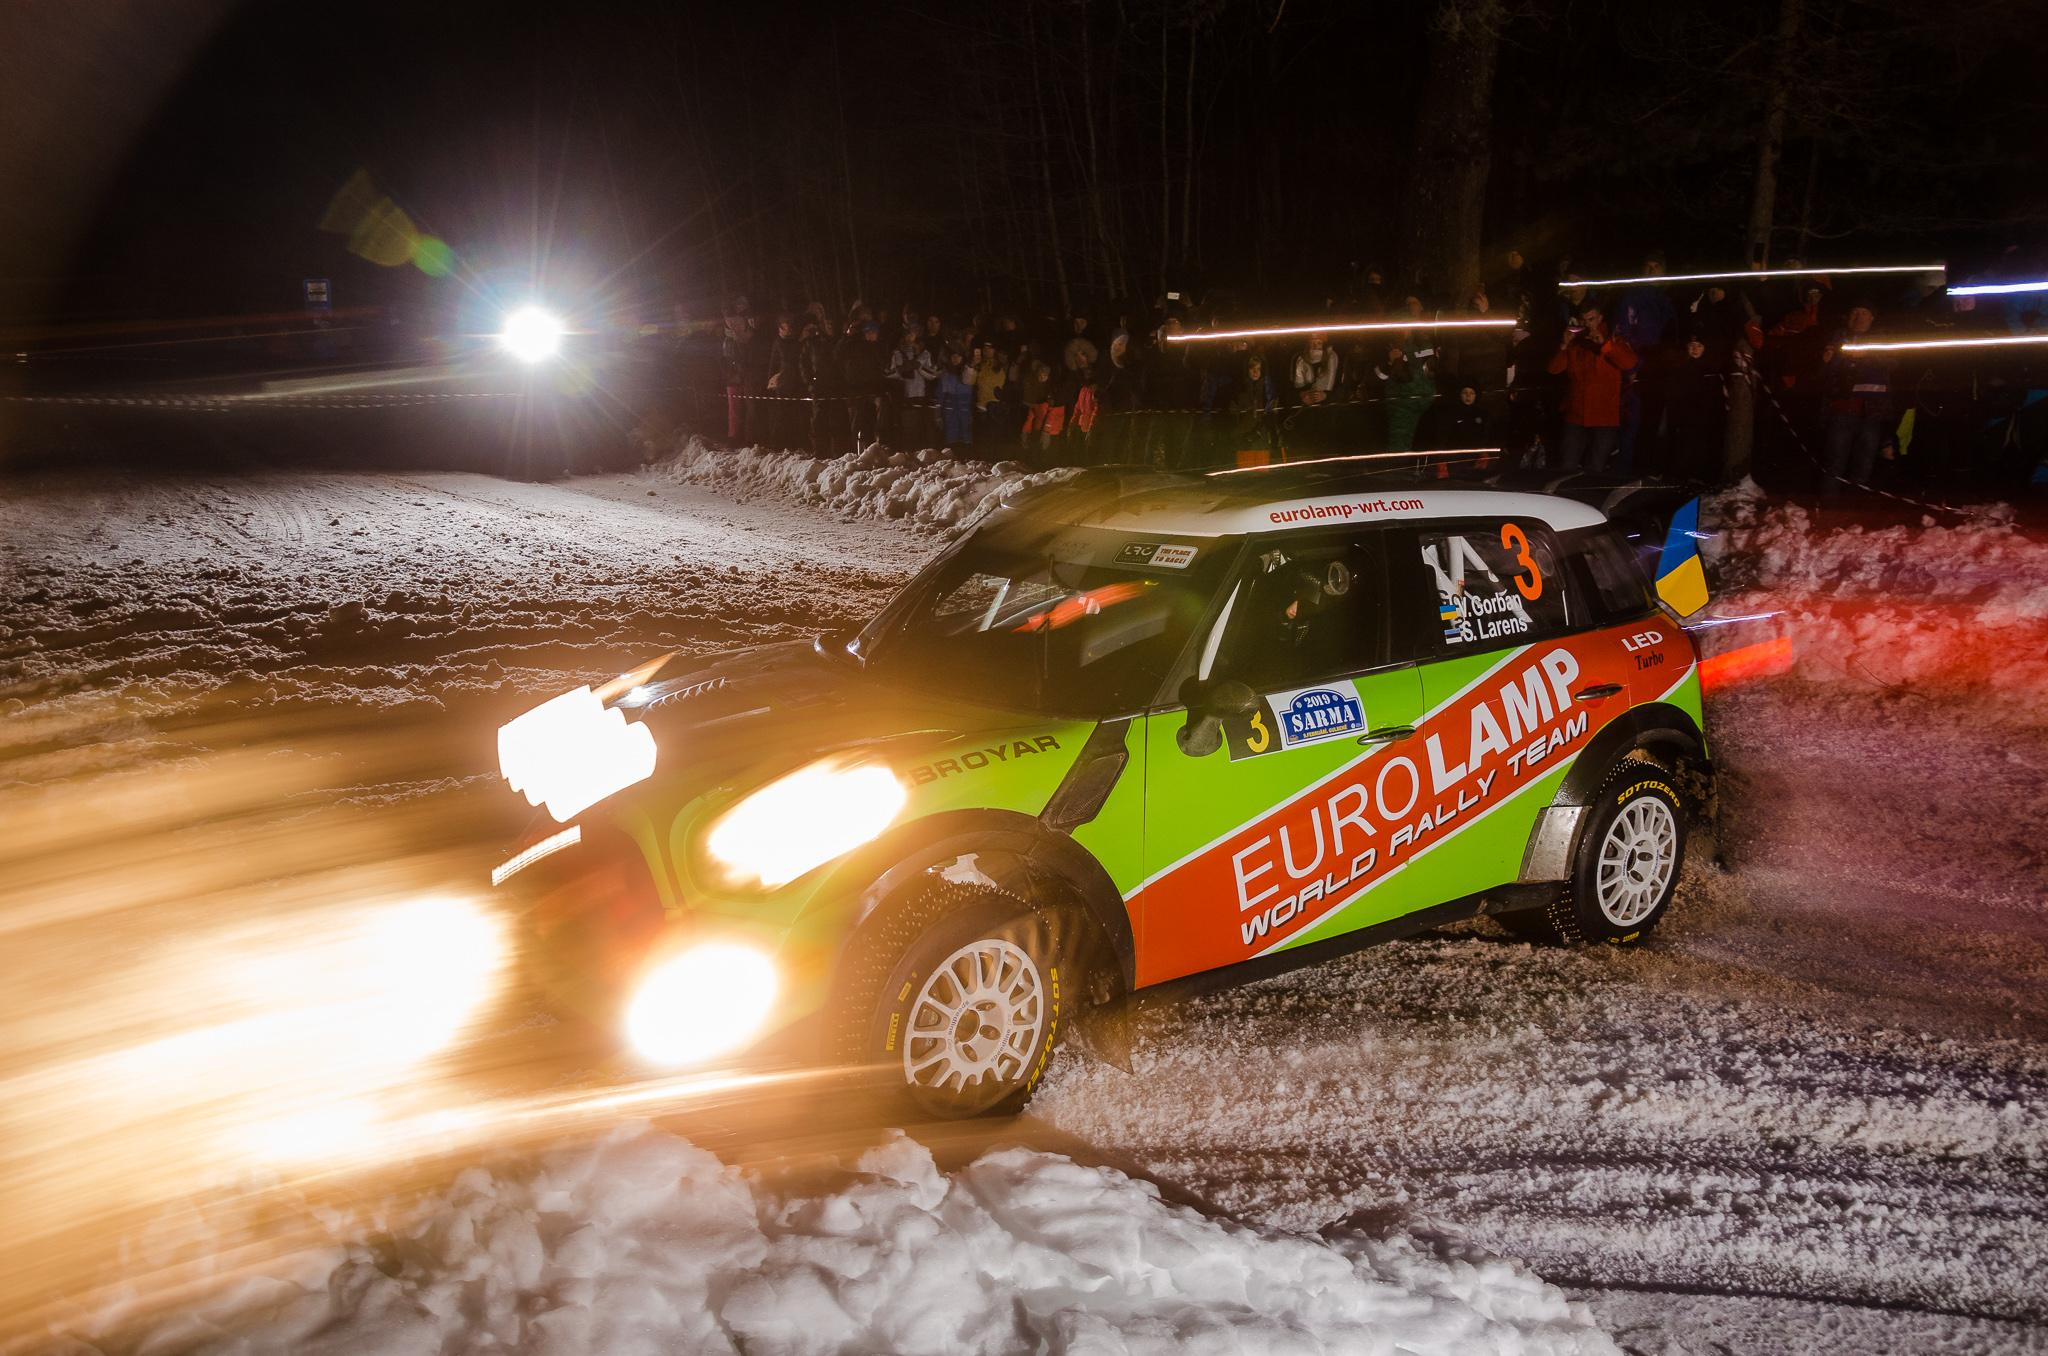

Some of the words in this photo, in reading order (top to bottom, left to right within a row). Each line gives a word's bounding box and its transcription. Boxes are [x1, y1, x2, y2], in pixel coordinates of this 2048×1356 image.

[1269, 496, 1424, 524] eurolamp-wrt.com
[1500, 522, 1543, 601] 3
[1472, 593, 1520, 616] Gorban
[1462, 621, 1478, 643] S.
[1478, 618, 1527, 638] Larens
[1620, 630, 1664, 652] LED
[1634, 650, 1664, 671] Turbo
[1303, 693, 1332, 709] 2019
[1246, 709, 1270, 754] 3
[1291, 704, 1356, 733] SARMA
[1231, 646, 1581, 912] EUROLAMP
[1616, 780, 1682, 819] SOTTOZERO
[1240, 846, 1377, 945] WORLD
[1389, 768, 1497, 857] RALLY
[1506, 710, 1589, 778] TEAM
